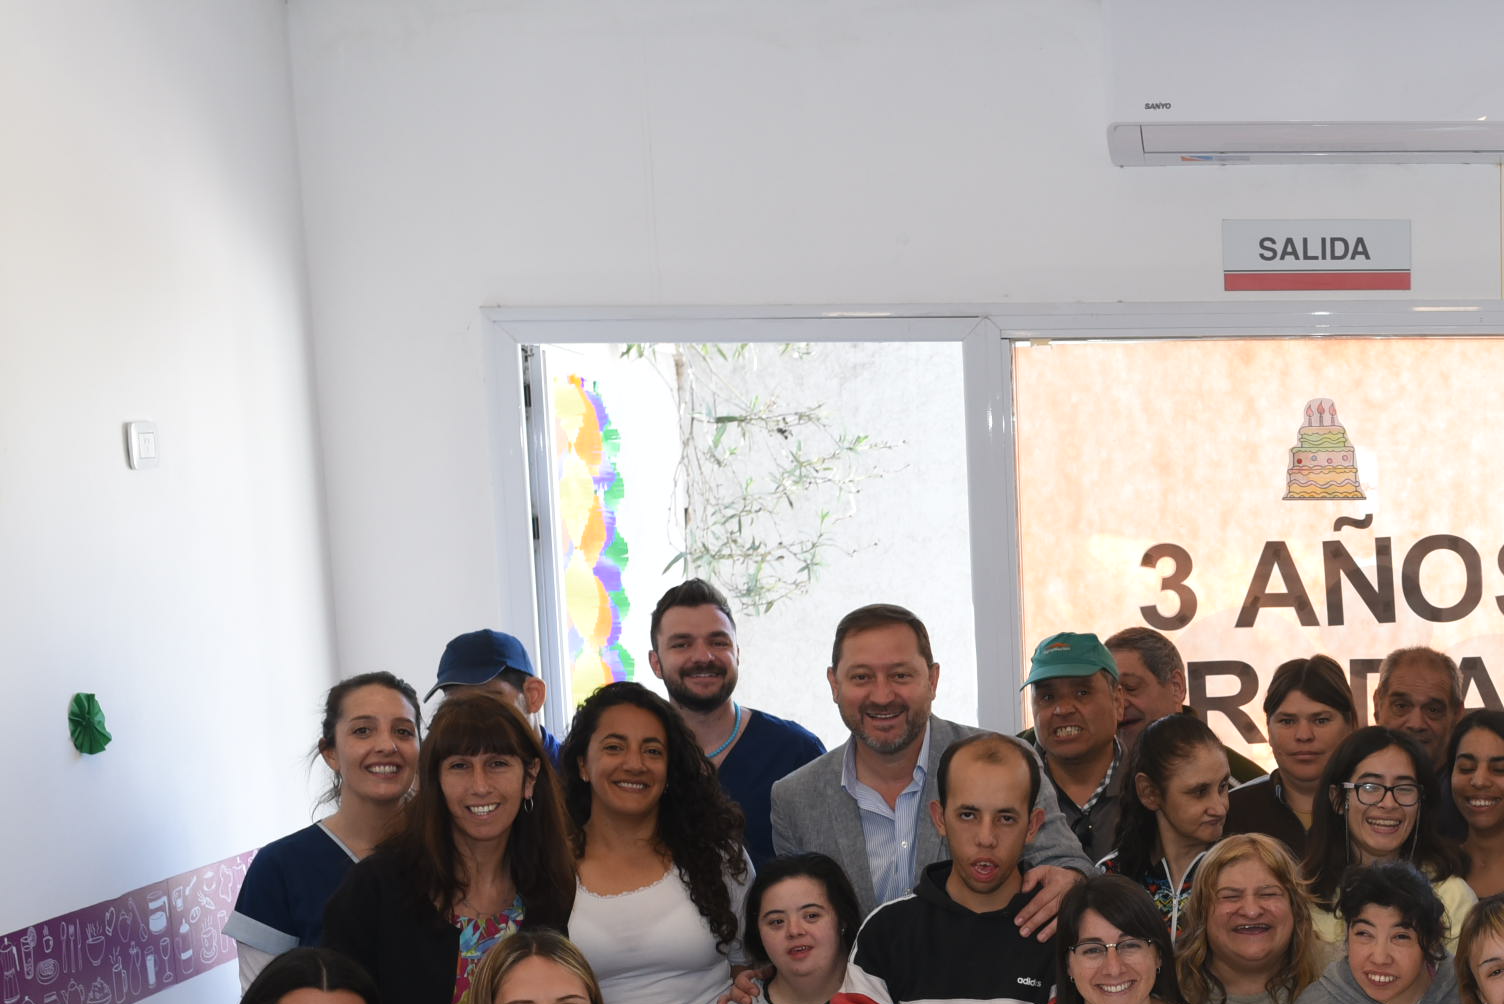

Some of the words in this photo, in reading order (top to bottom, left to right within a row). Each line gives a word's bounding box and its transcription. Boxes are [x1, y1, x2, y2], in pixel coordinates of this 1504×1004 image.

[1144, 102, 1172, 110] SANYO
[1258, 236, 1371, 261] SALIDA
[1140, 542, 1198, 631] 3
